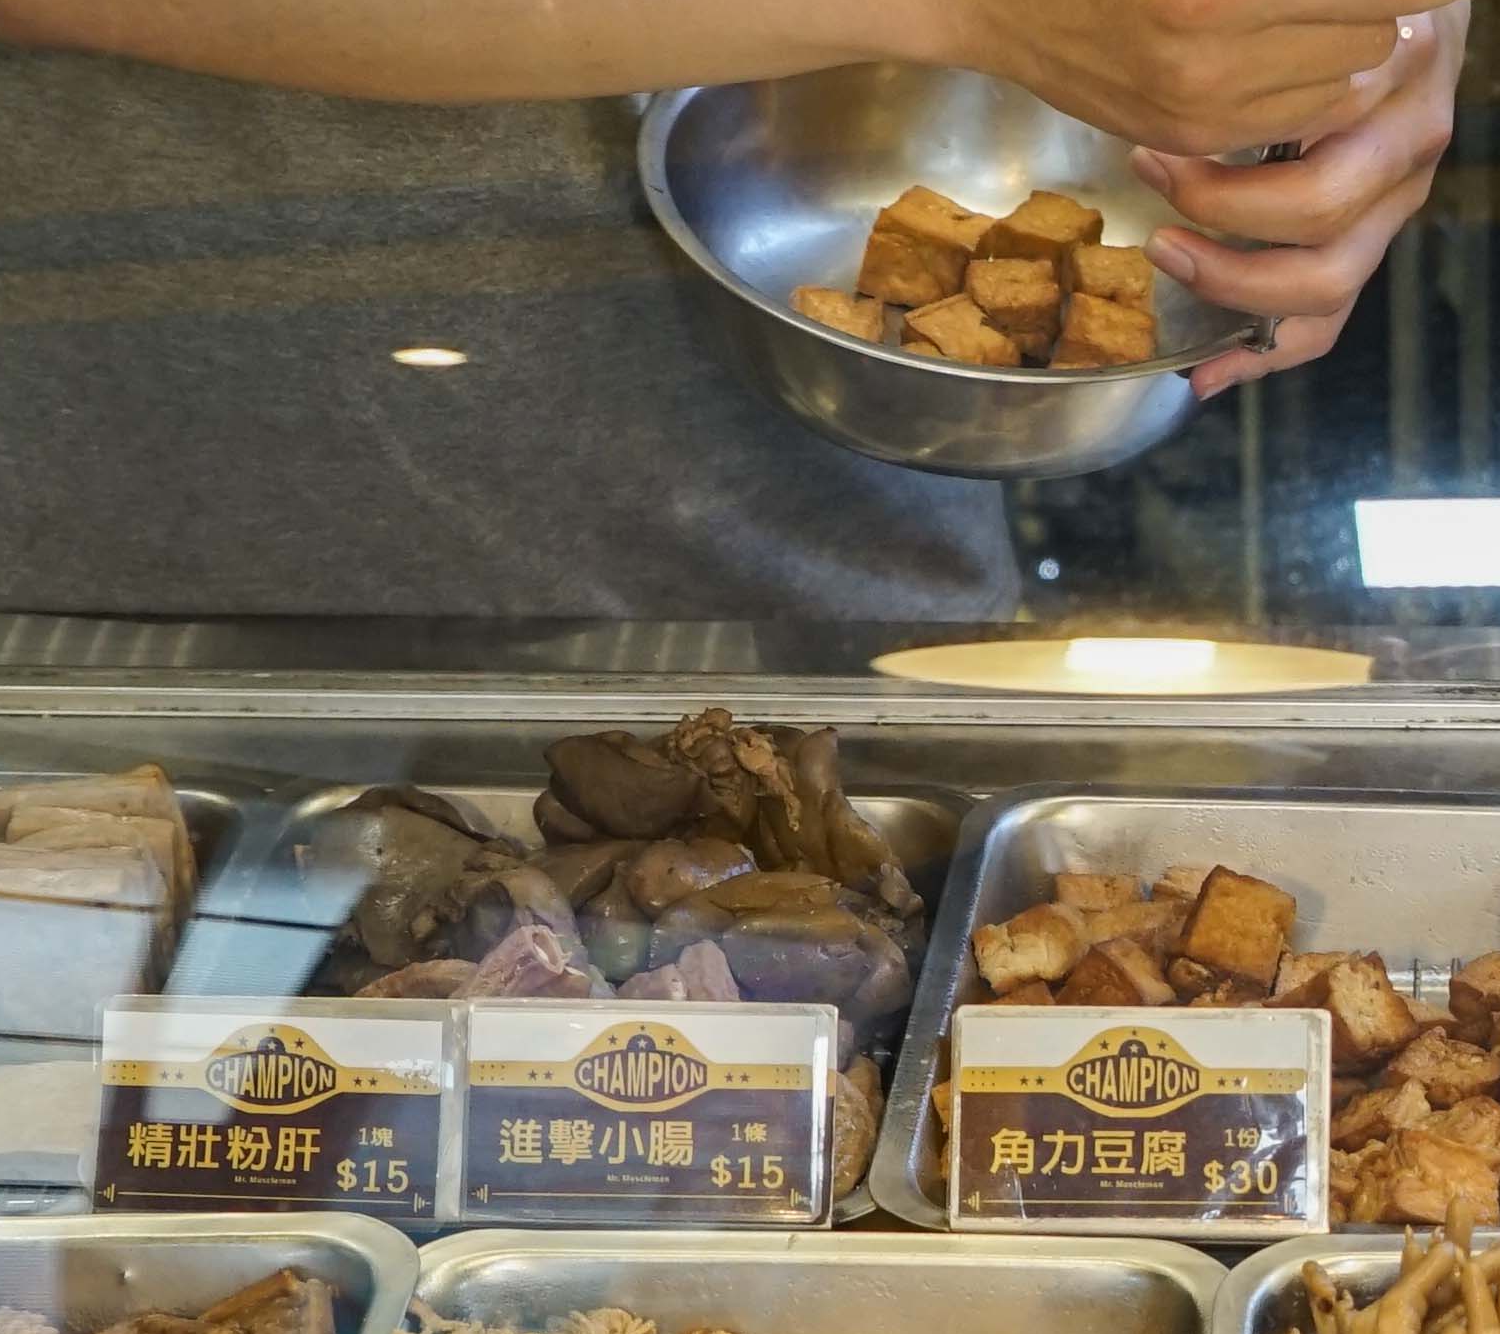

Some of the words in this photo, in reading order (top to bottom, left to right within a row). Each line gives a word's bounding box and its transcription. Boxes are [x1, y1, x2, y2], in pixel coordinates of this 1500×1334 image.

[206, 1054, 336, 1099] CHAMPION
[577, 1052, 706, 1098] CHAMPION
[1067, 1057, 1199, 1102] CHAMPION
[126, 1121, 322, 1173] 精壯粉肝
[497, 1117, 694, 1167] 進擊小腸
[989, 1127, 1188, 1177] 角力豆腐
[335, 1157, 410, 1194] $15
[710, 1155, 785, 1189] $15
[1203, 1158, 1279, 1195] $30
